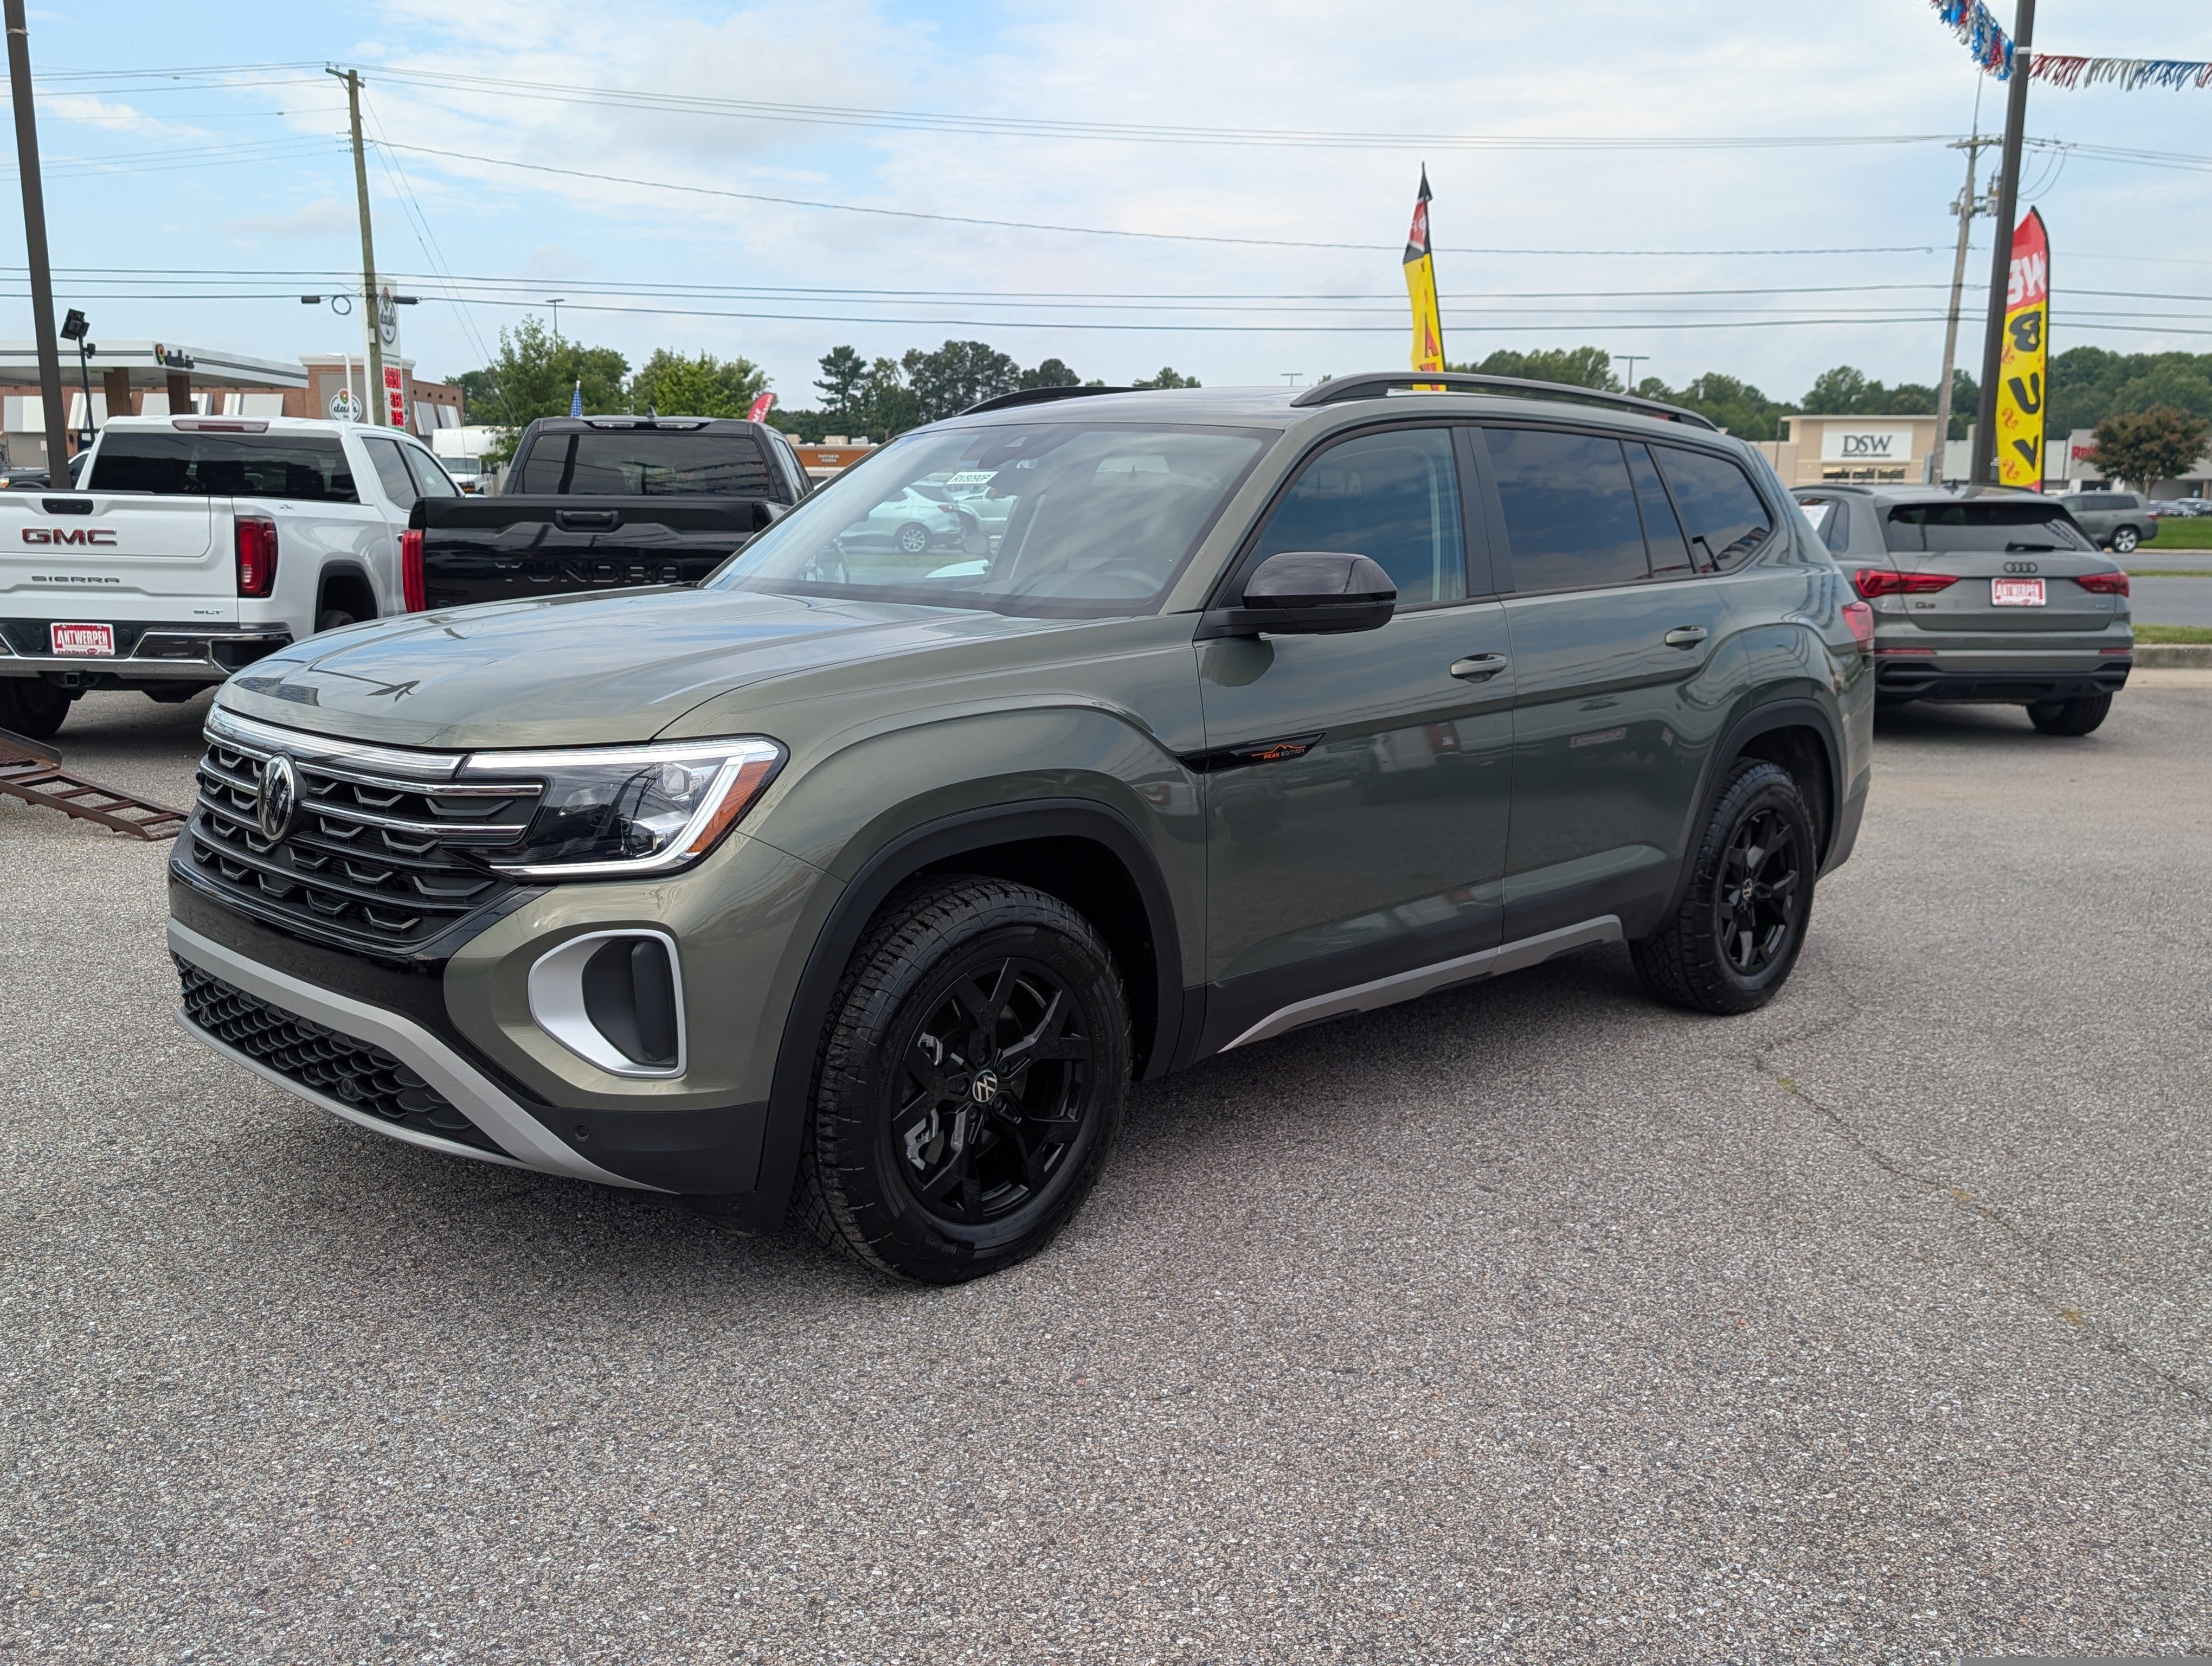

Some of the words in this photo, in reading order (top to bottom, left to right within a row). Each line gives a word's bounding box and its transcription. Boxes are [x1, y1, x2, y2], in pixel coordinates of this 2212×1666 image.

[1843, 434, 1893, 452] DSW
[22, 527, 118, 546] GMC
[31, 575, 120, 584] SIERRA
[494, 561, 684, 584] TUNDRA
[57, 630, 108, 645] ANTWERPEN
